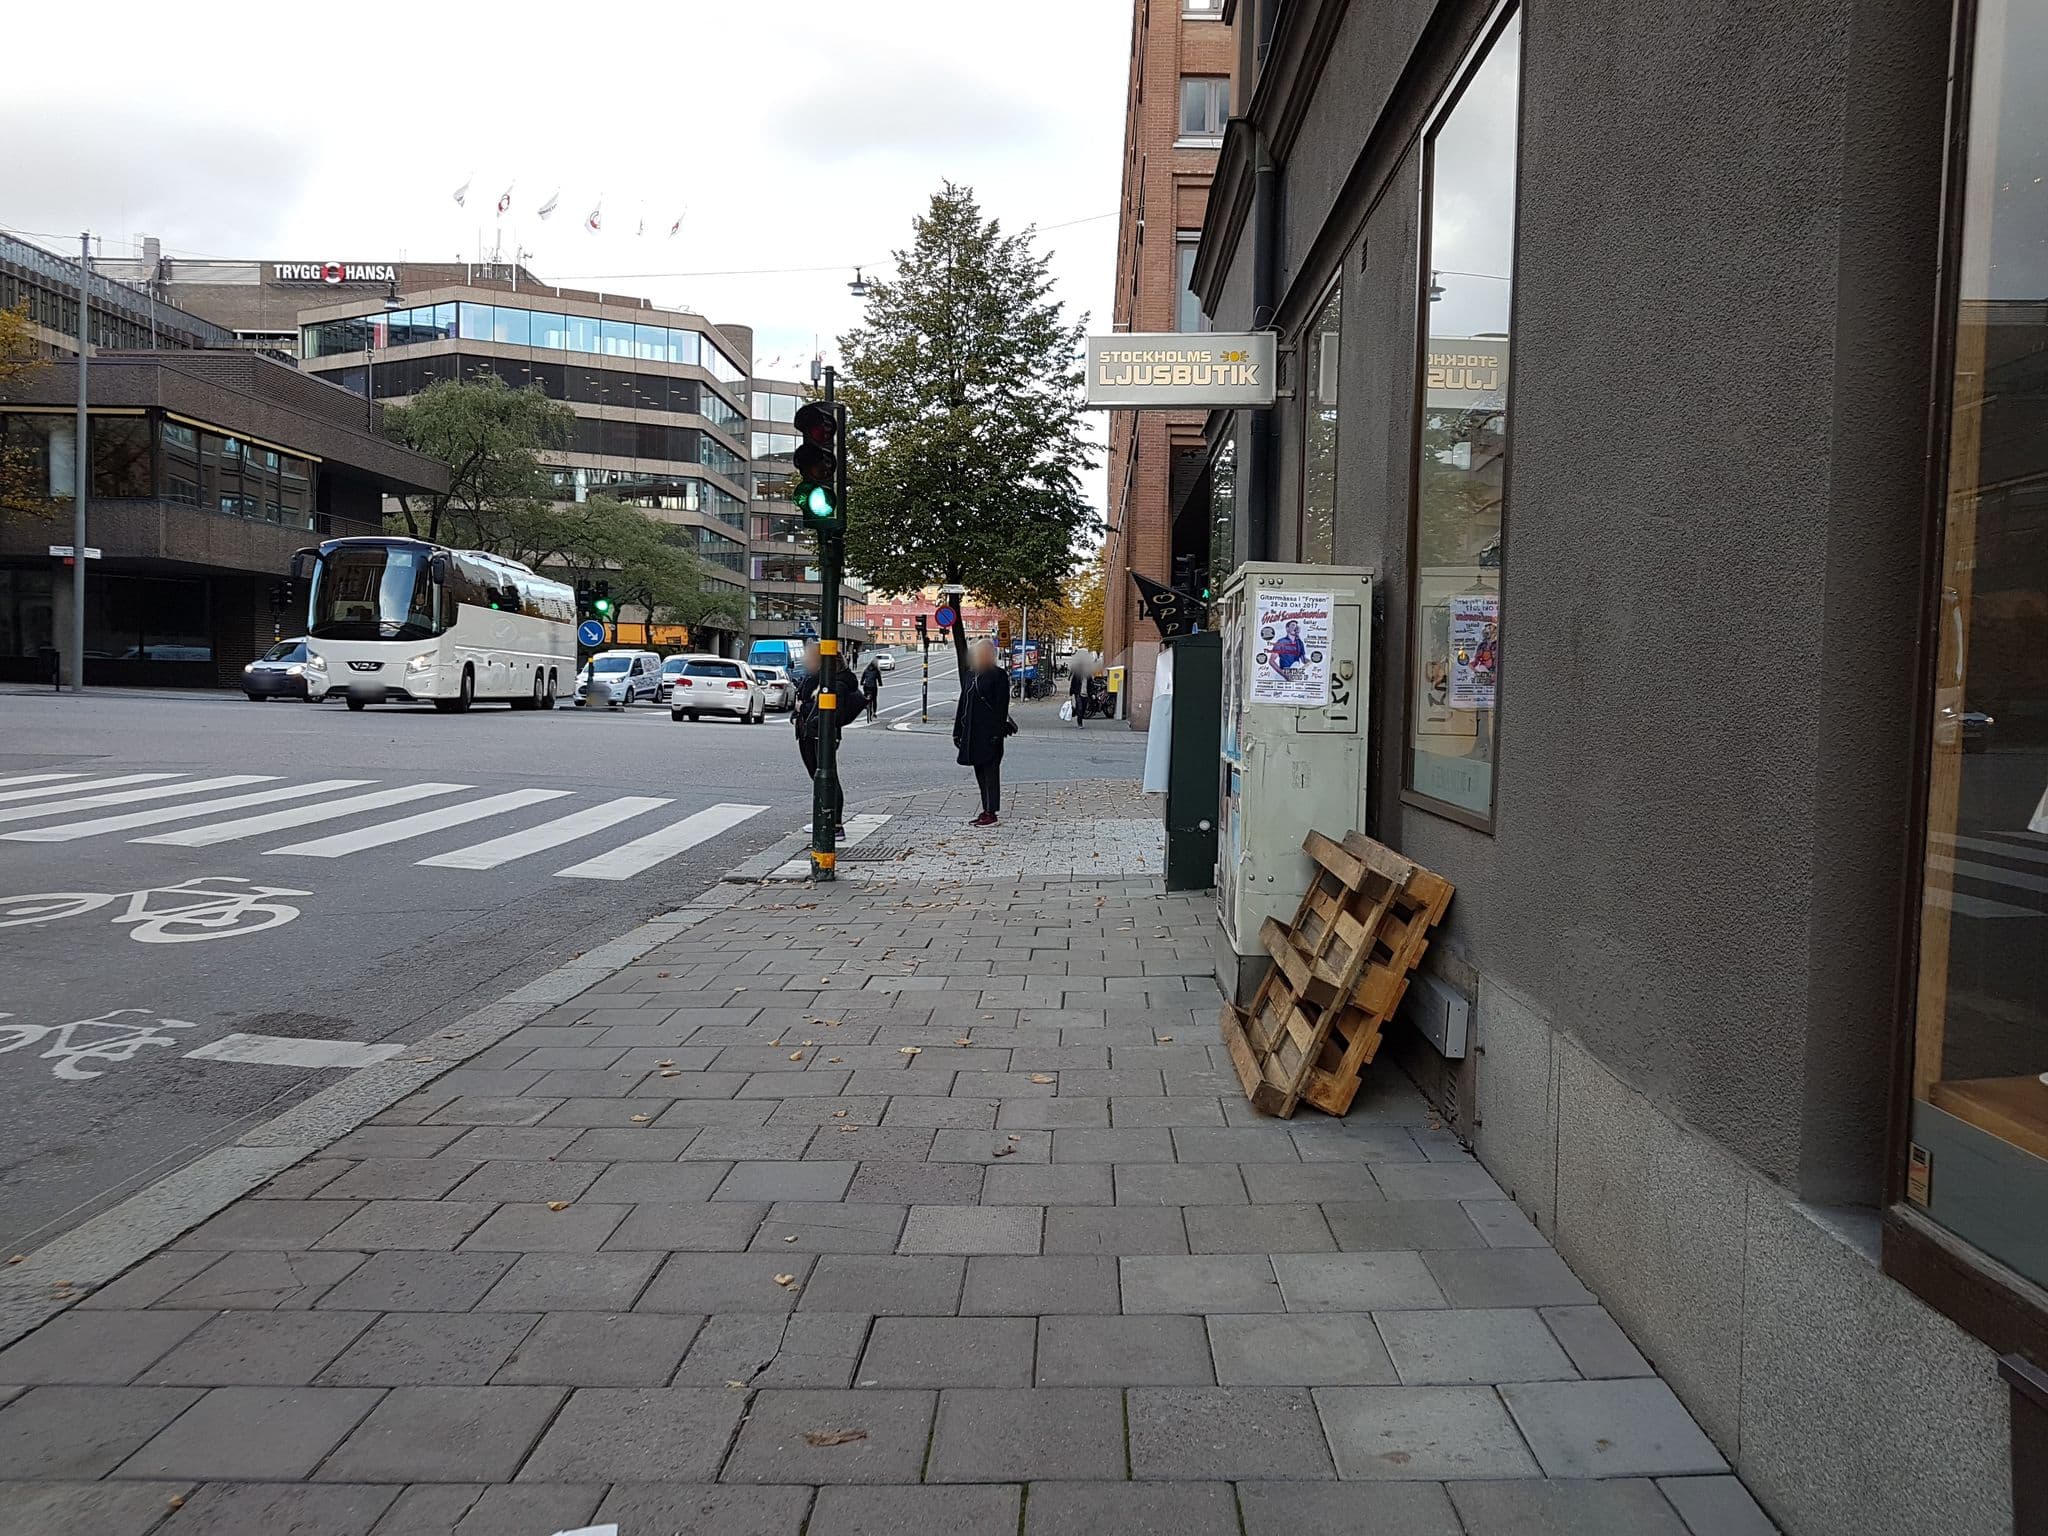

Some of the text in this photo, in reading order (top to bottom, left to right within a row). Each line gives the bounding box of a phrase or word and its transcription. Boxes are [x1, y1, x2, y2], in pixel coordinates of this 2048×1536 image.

[274, 264, 396, 280] TRYGG HANSA
[1099, 350, 1212, 363] STOCKHOLMS
[1099, 364, 1260, 386] LJUSBUTIK
[351, 661, 377, 669] VDL
